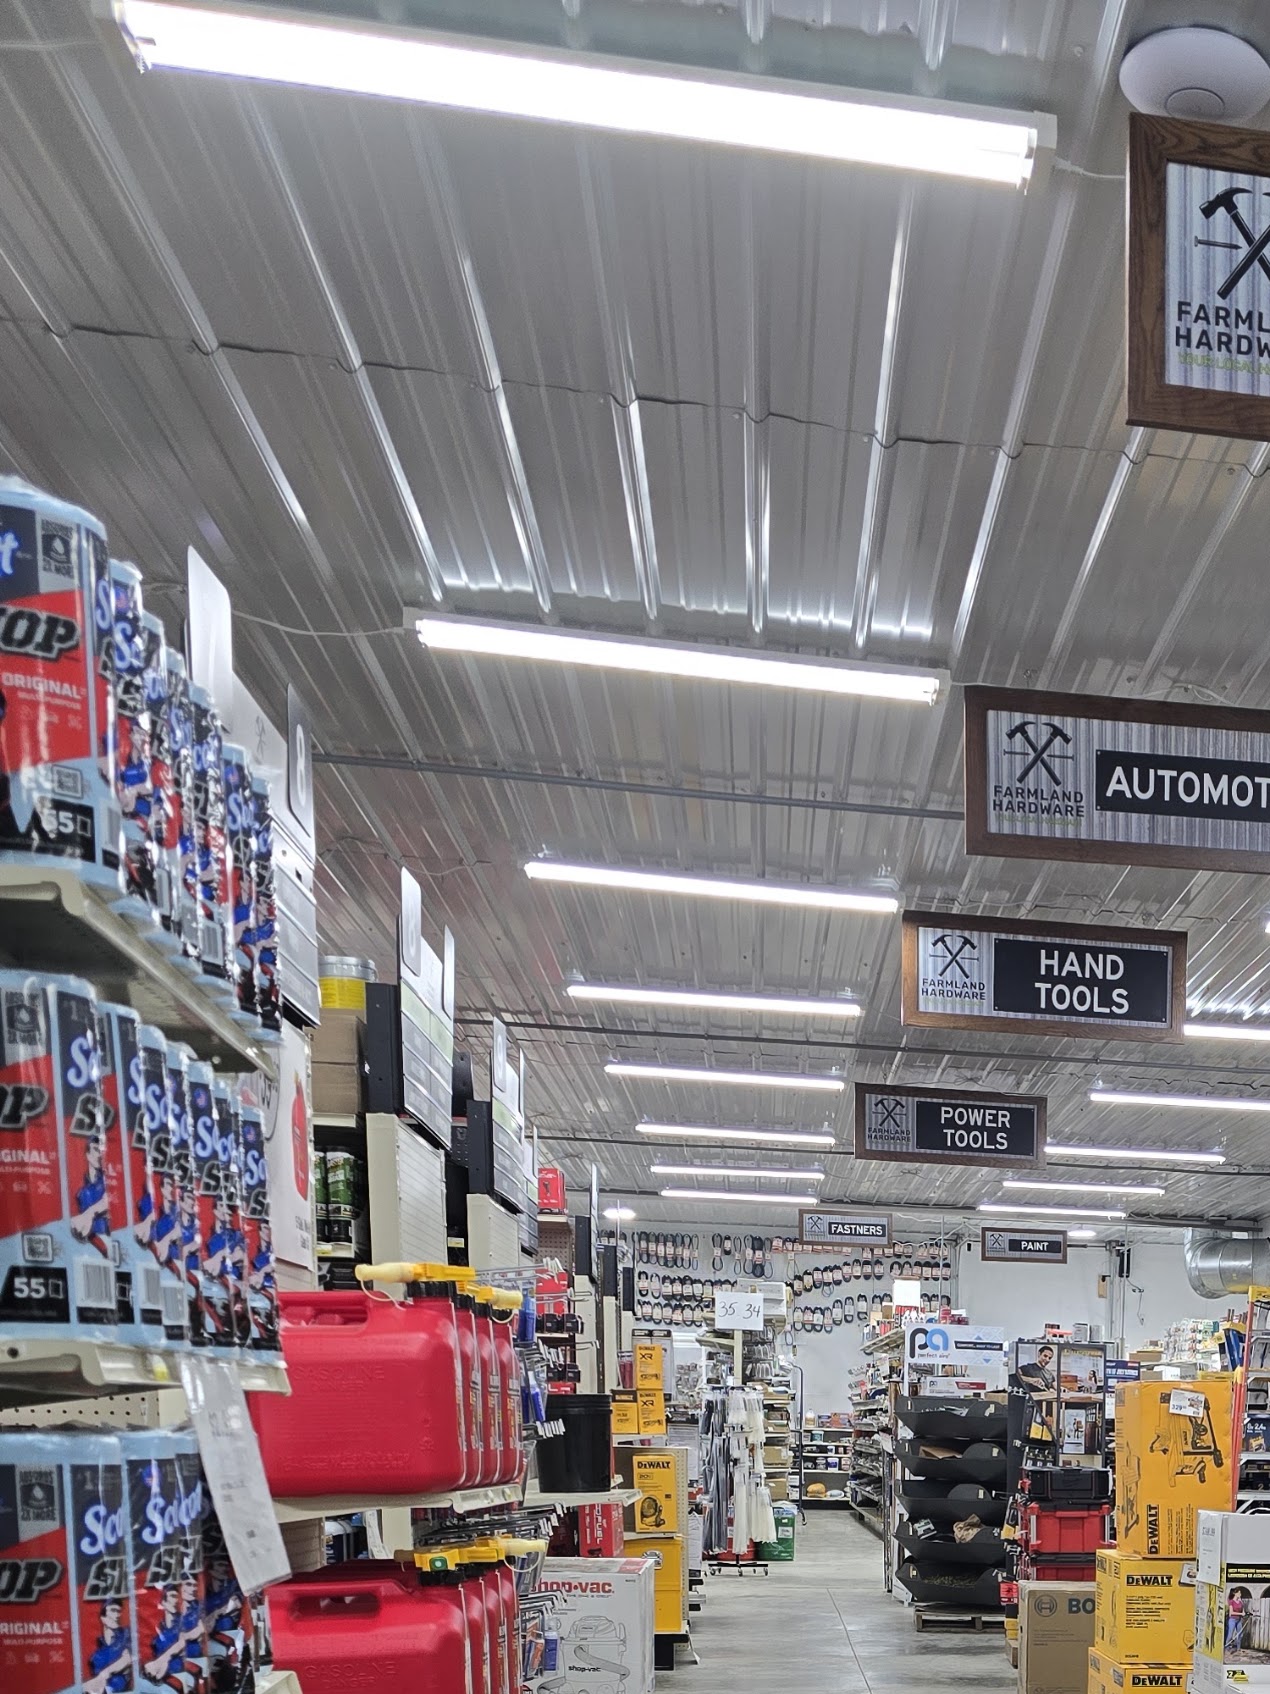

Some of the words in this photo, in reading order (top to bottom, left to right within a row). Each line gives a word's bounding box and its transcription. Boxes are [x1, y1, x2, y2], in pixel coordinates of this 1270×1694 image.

[1, 671, 82, 700] ORIGINAL
[993, 785, 1084, 803] FARMLAND
[992, 799, 1085, 817] HARDWARE
[1039, 949, 1125, 981] HAND
[921, 987, 986, 1001] HARDWARE
[922, 978, 986, 992] FARMLAND
[1034, 982, 1130, 1015] TOOLS
[940, 1106, 1011, 1129] POWER
[867, 1133, 912, 1143] HARDWARE
[943, 1128, 1008, 1150] TOOLS
[0, 1150, 50, 1166] GINAL
[831, 1223, 883, 1236] FASTNERS
[1020, 1240, 1050, 1252] PAINT
[13, 1279, 47, 1299] 55
[718, 1301, 738, 1318] 35
[742, 1303, 761, 1319] 34
[1147, 1504, 1160, 1555] DEWALT
[1126, 1575, 1173, 1587] DEWALT
[0, 1621, 63, 1636] RIGINAL
[1132, 1675, 1183, 1687] DEWALT
